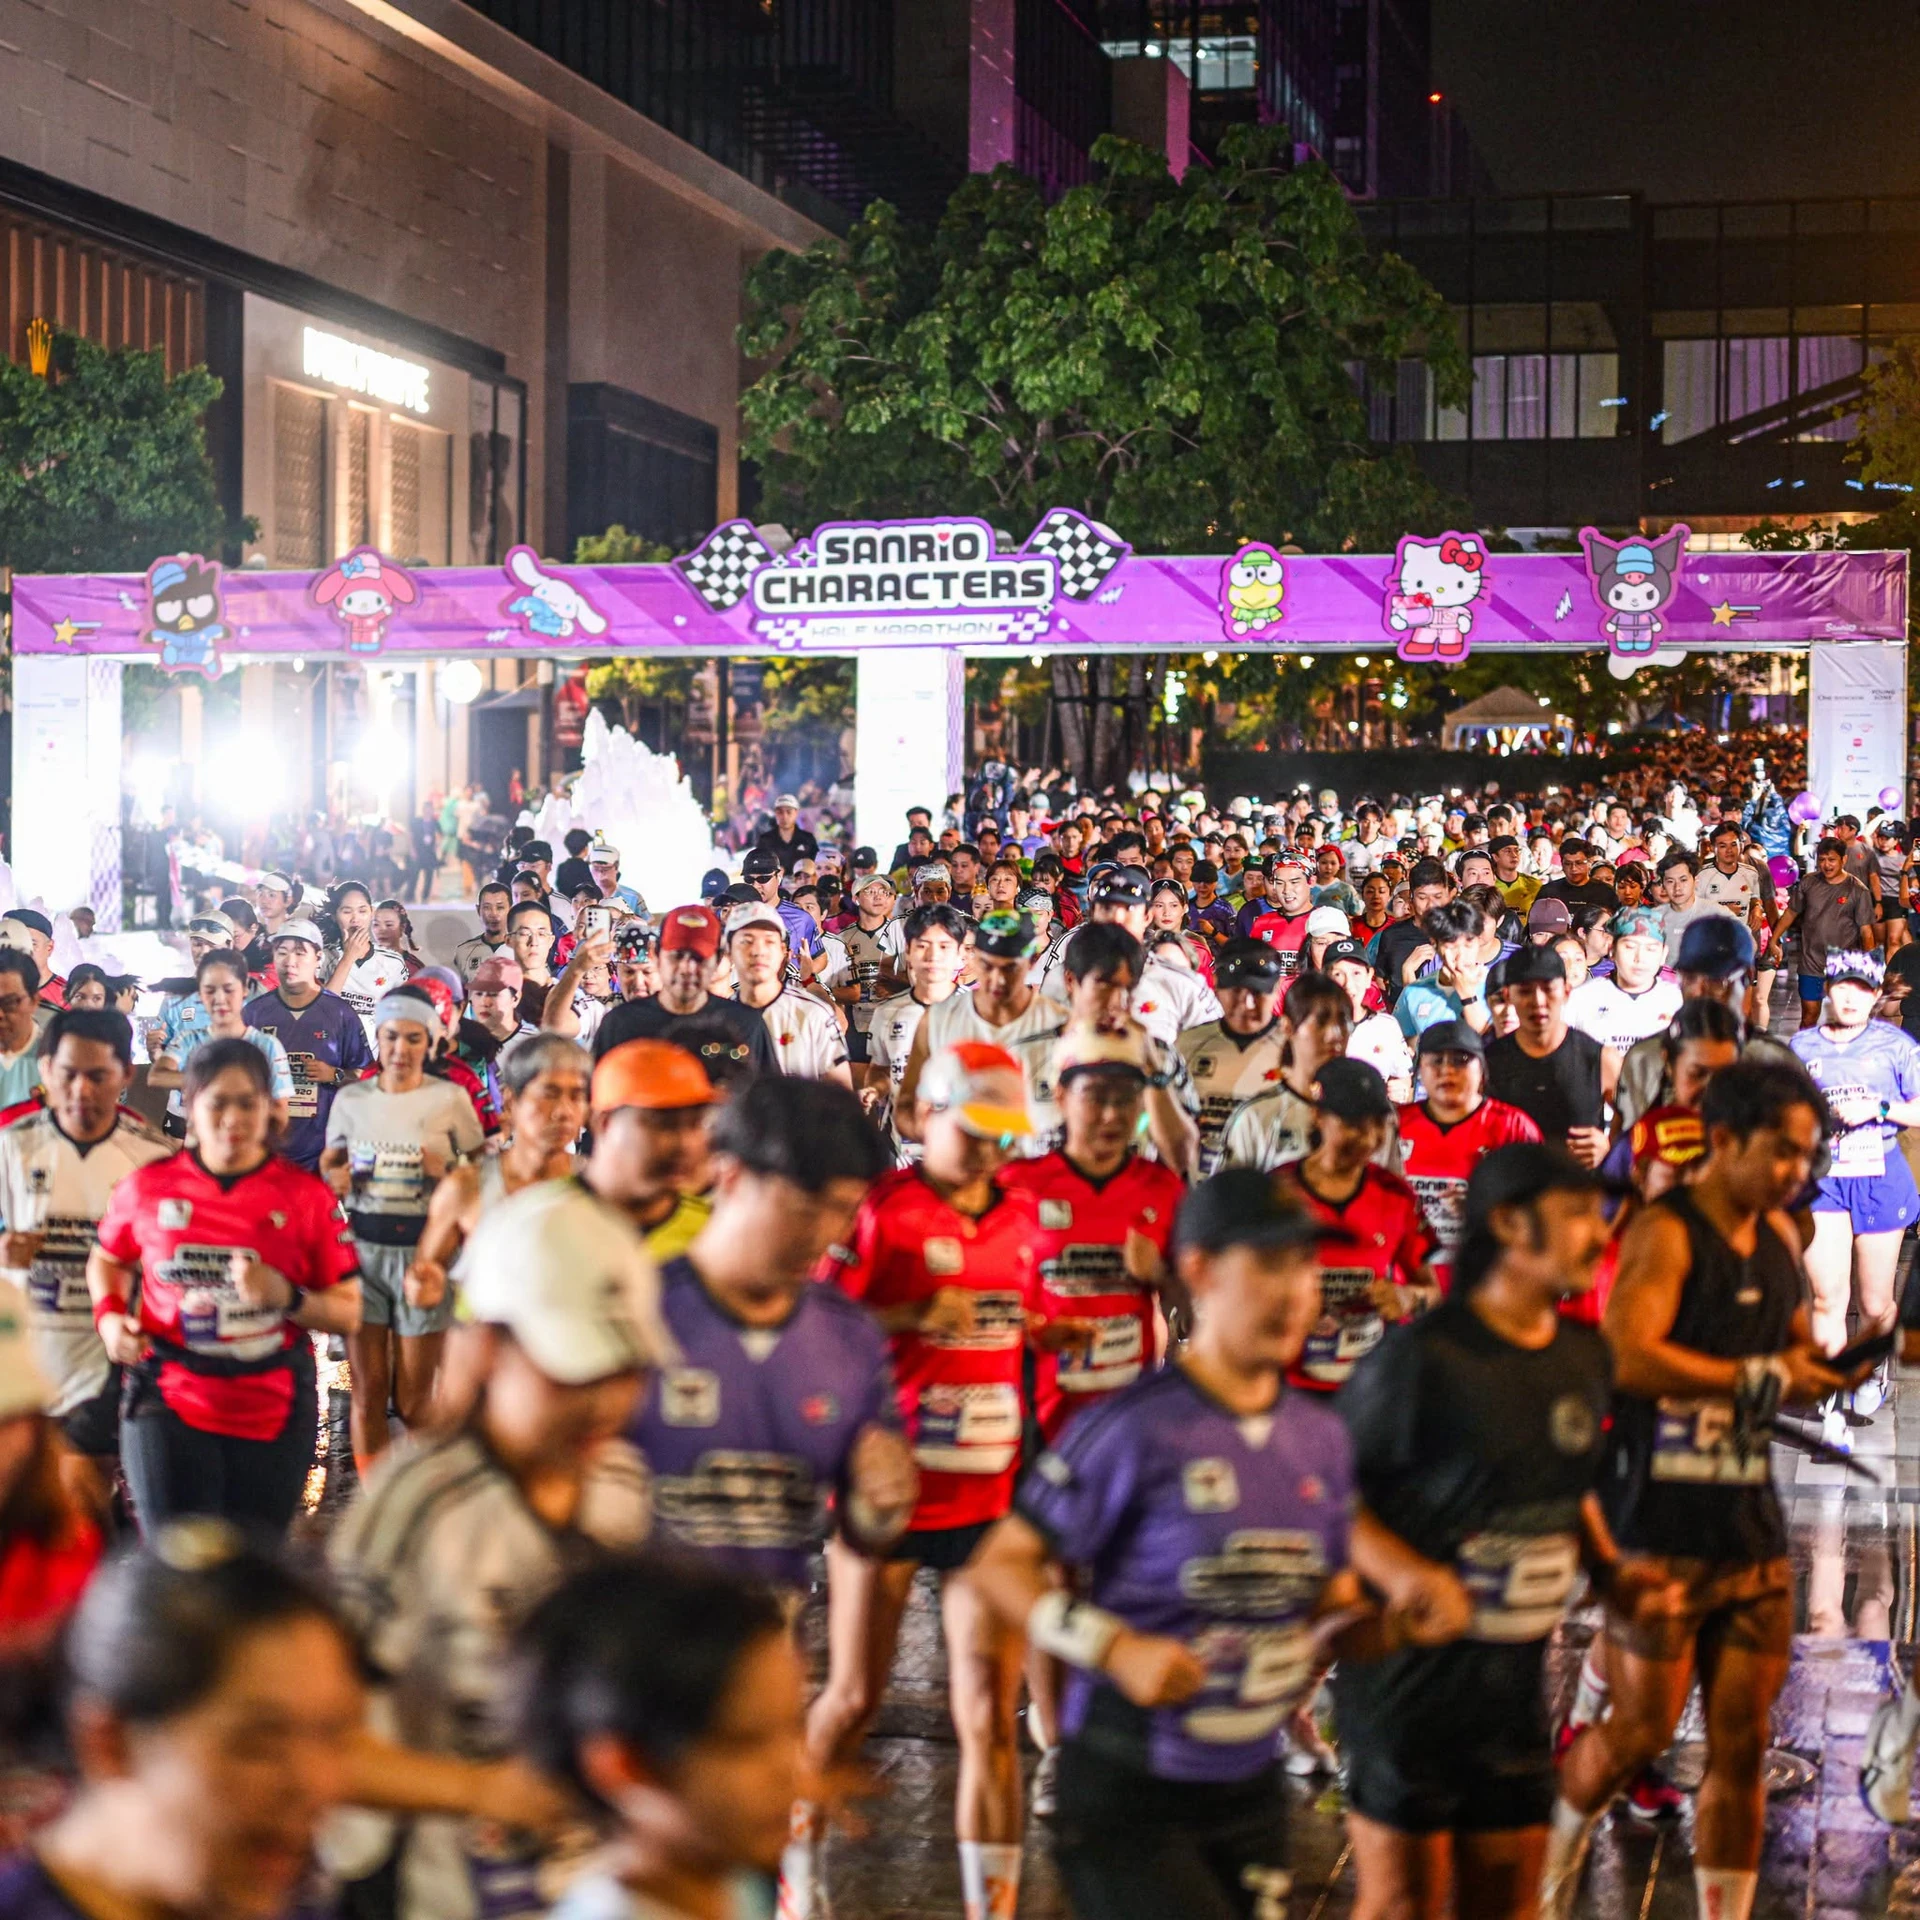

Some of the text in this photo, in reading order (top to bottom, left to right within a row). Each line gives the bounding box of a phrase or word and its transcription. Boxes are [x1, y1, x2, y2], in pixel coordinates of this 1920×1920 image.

[761, 568, 1046, 605] CHARACTERS
[812, 621, 992, 638] HALF MARATHON
